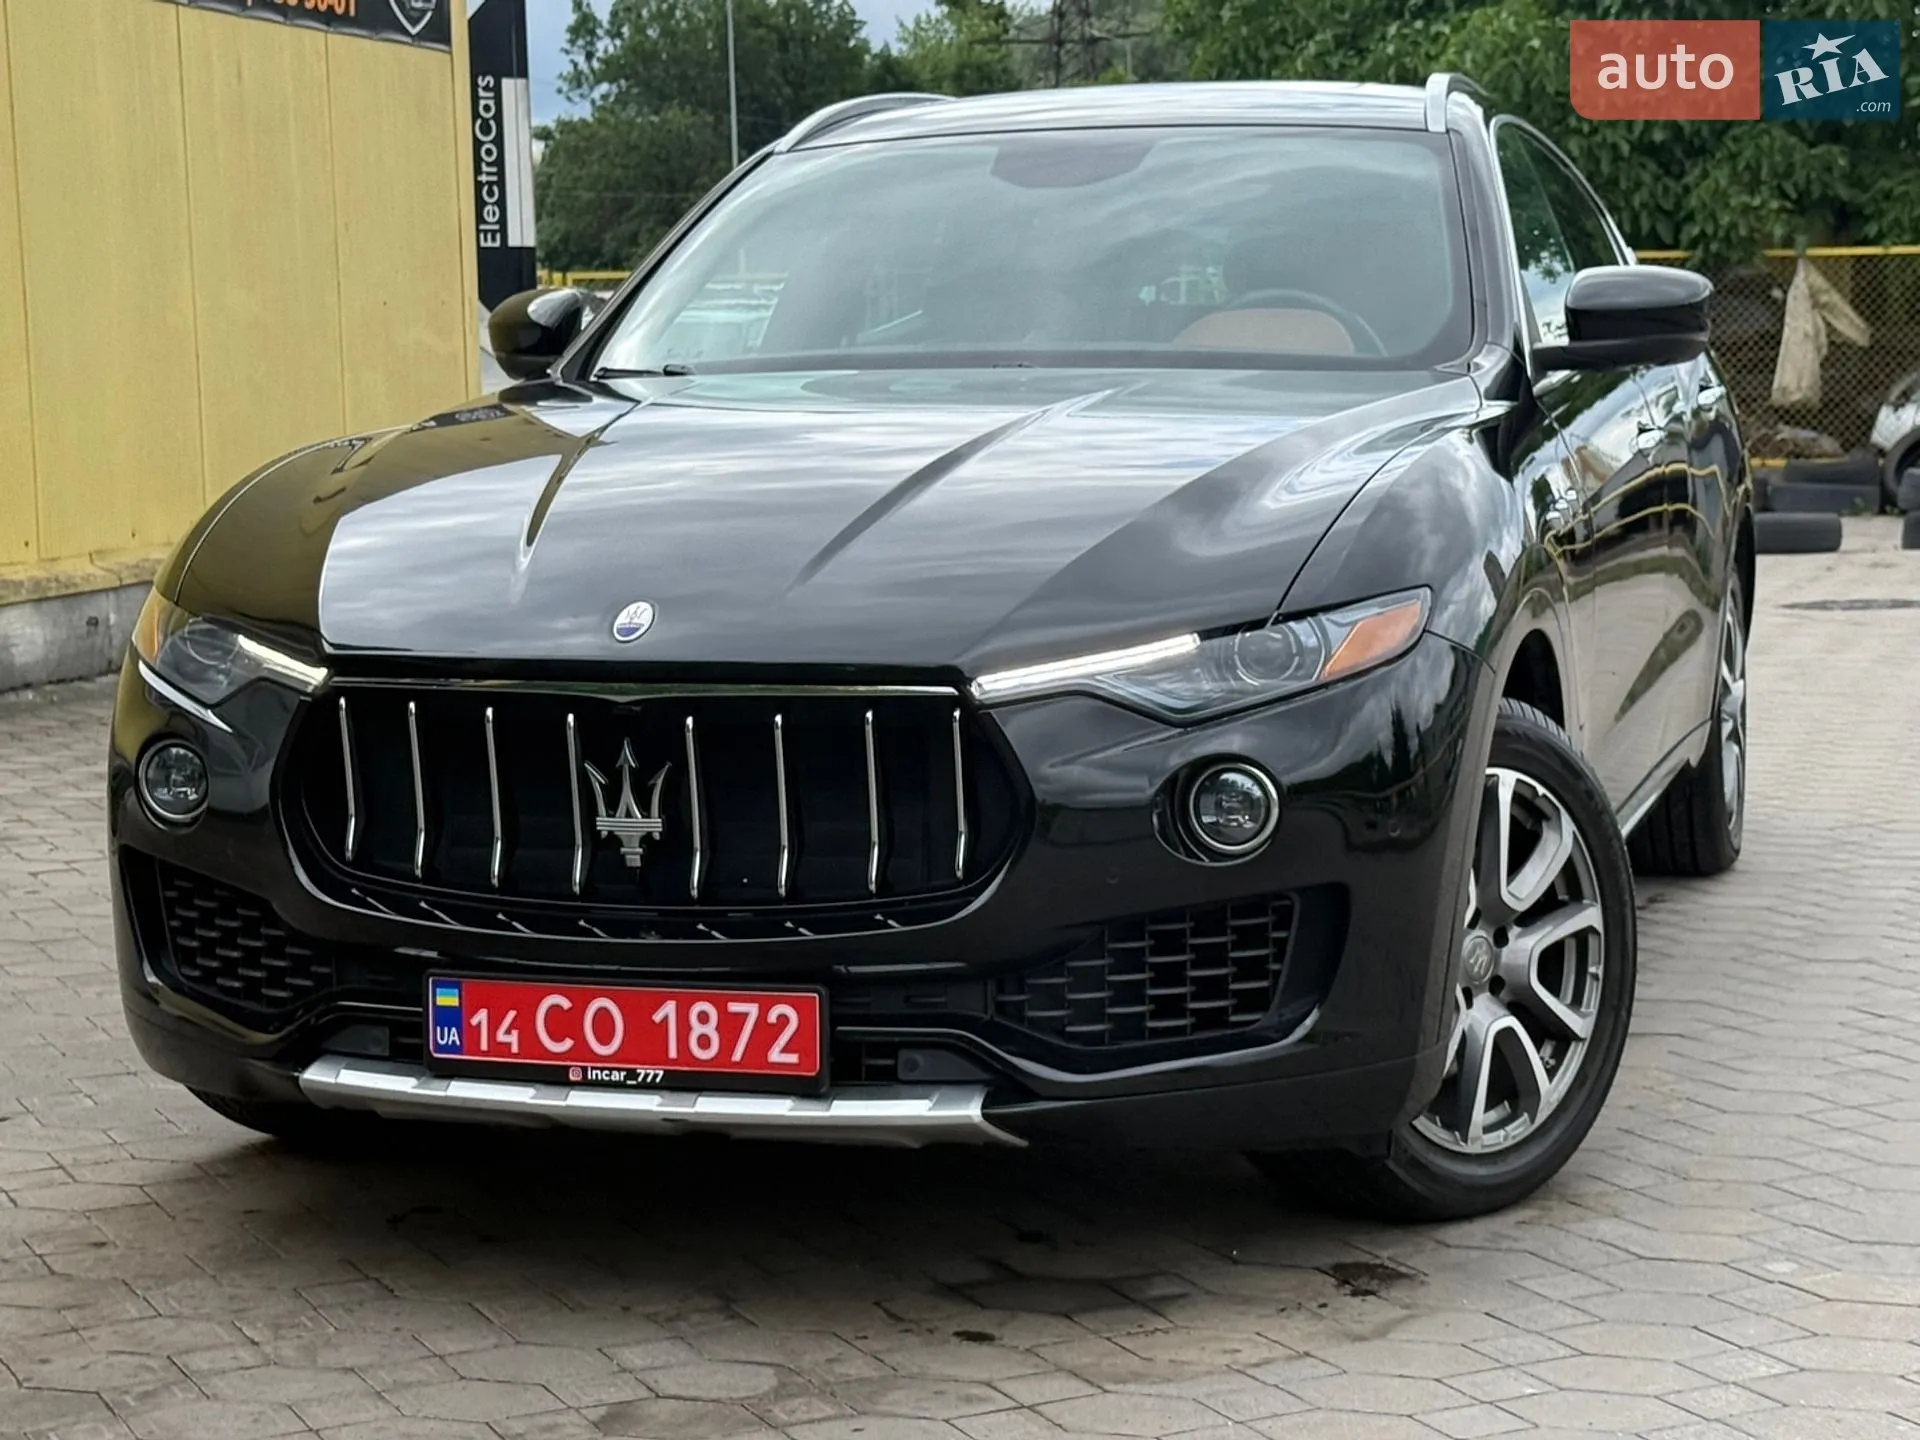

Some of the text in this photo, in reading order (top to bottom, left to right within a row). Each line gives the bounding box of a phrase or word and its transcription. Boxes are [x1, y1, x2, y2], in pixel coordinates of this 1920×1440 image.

[475, 74, 501, 248] ElectroCars
[436, 1026, 461, 1047] UA
[469, 993, 800, 1064] 14 CO 1872
